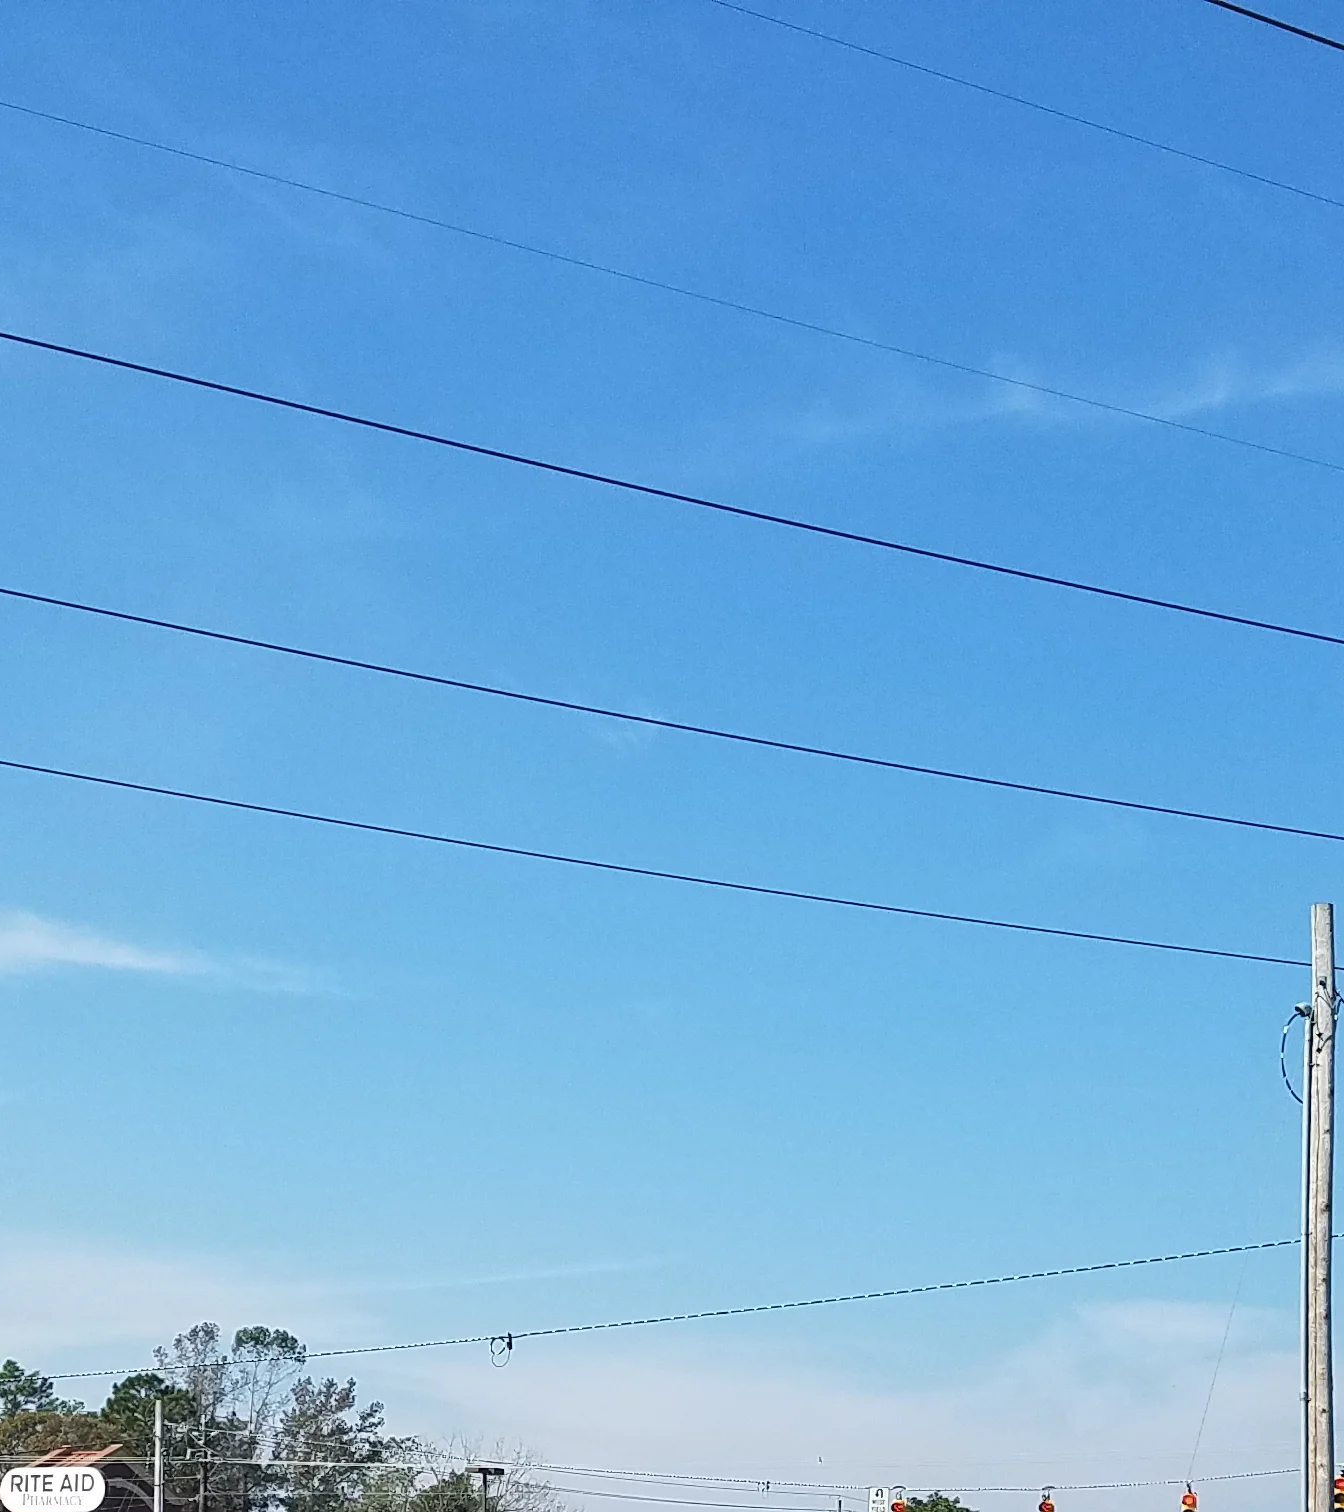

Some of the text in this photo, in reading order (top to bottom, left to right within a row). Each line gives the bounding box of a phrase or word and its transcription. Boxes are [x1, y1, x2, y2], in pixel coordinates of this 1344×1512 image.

[11, 1474, 94, 1492] RITE AID
[22, 1494, 83, 1506] PHARMACY
